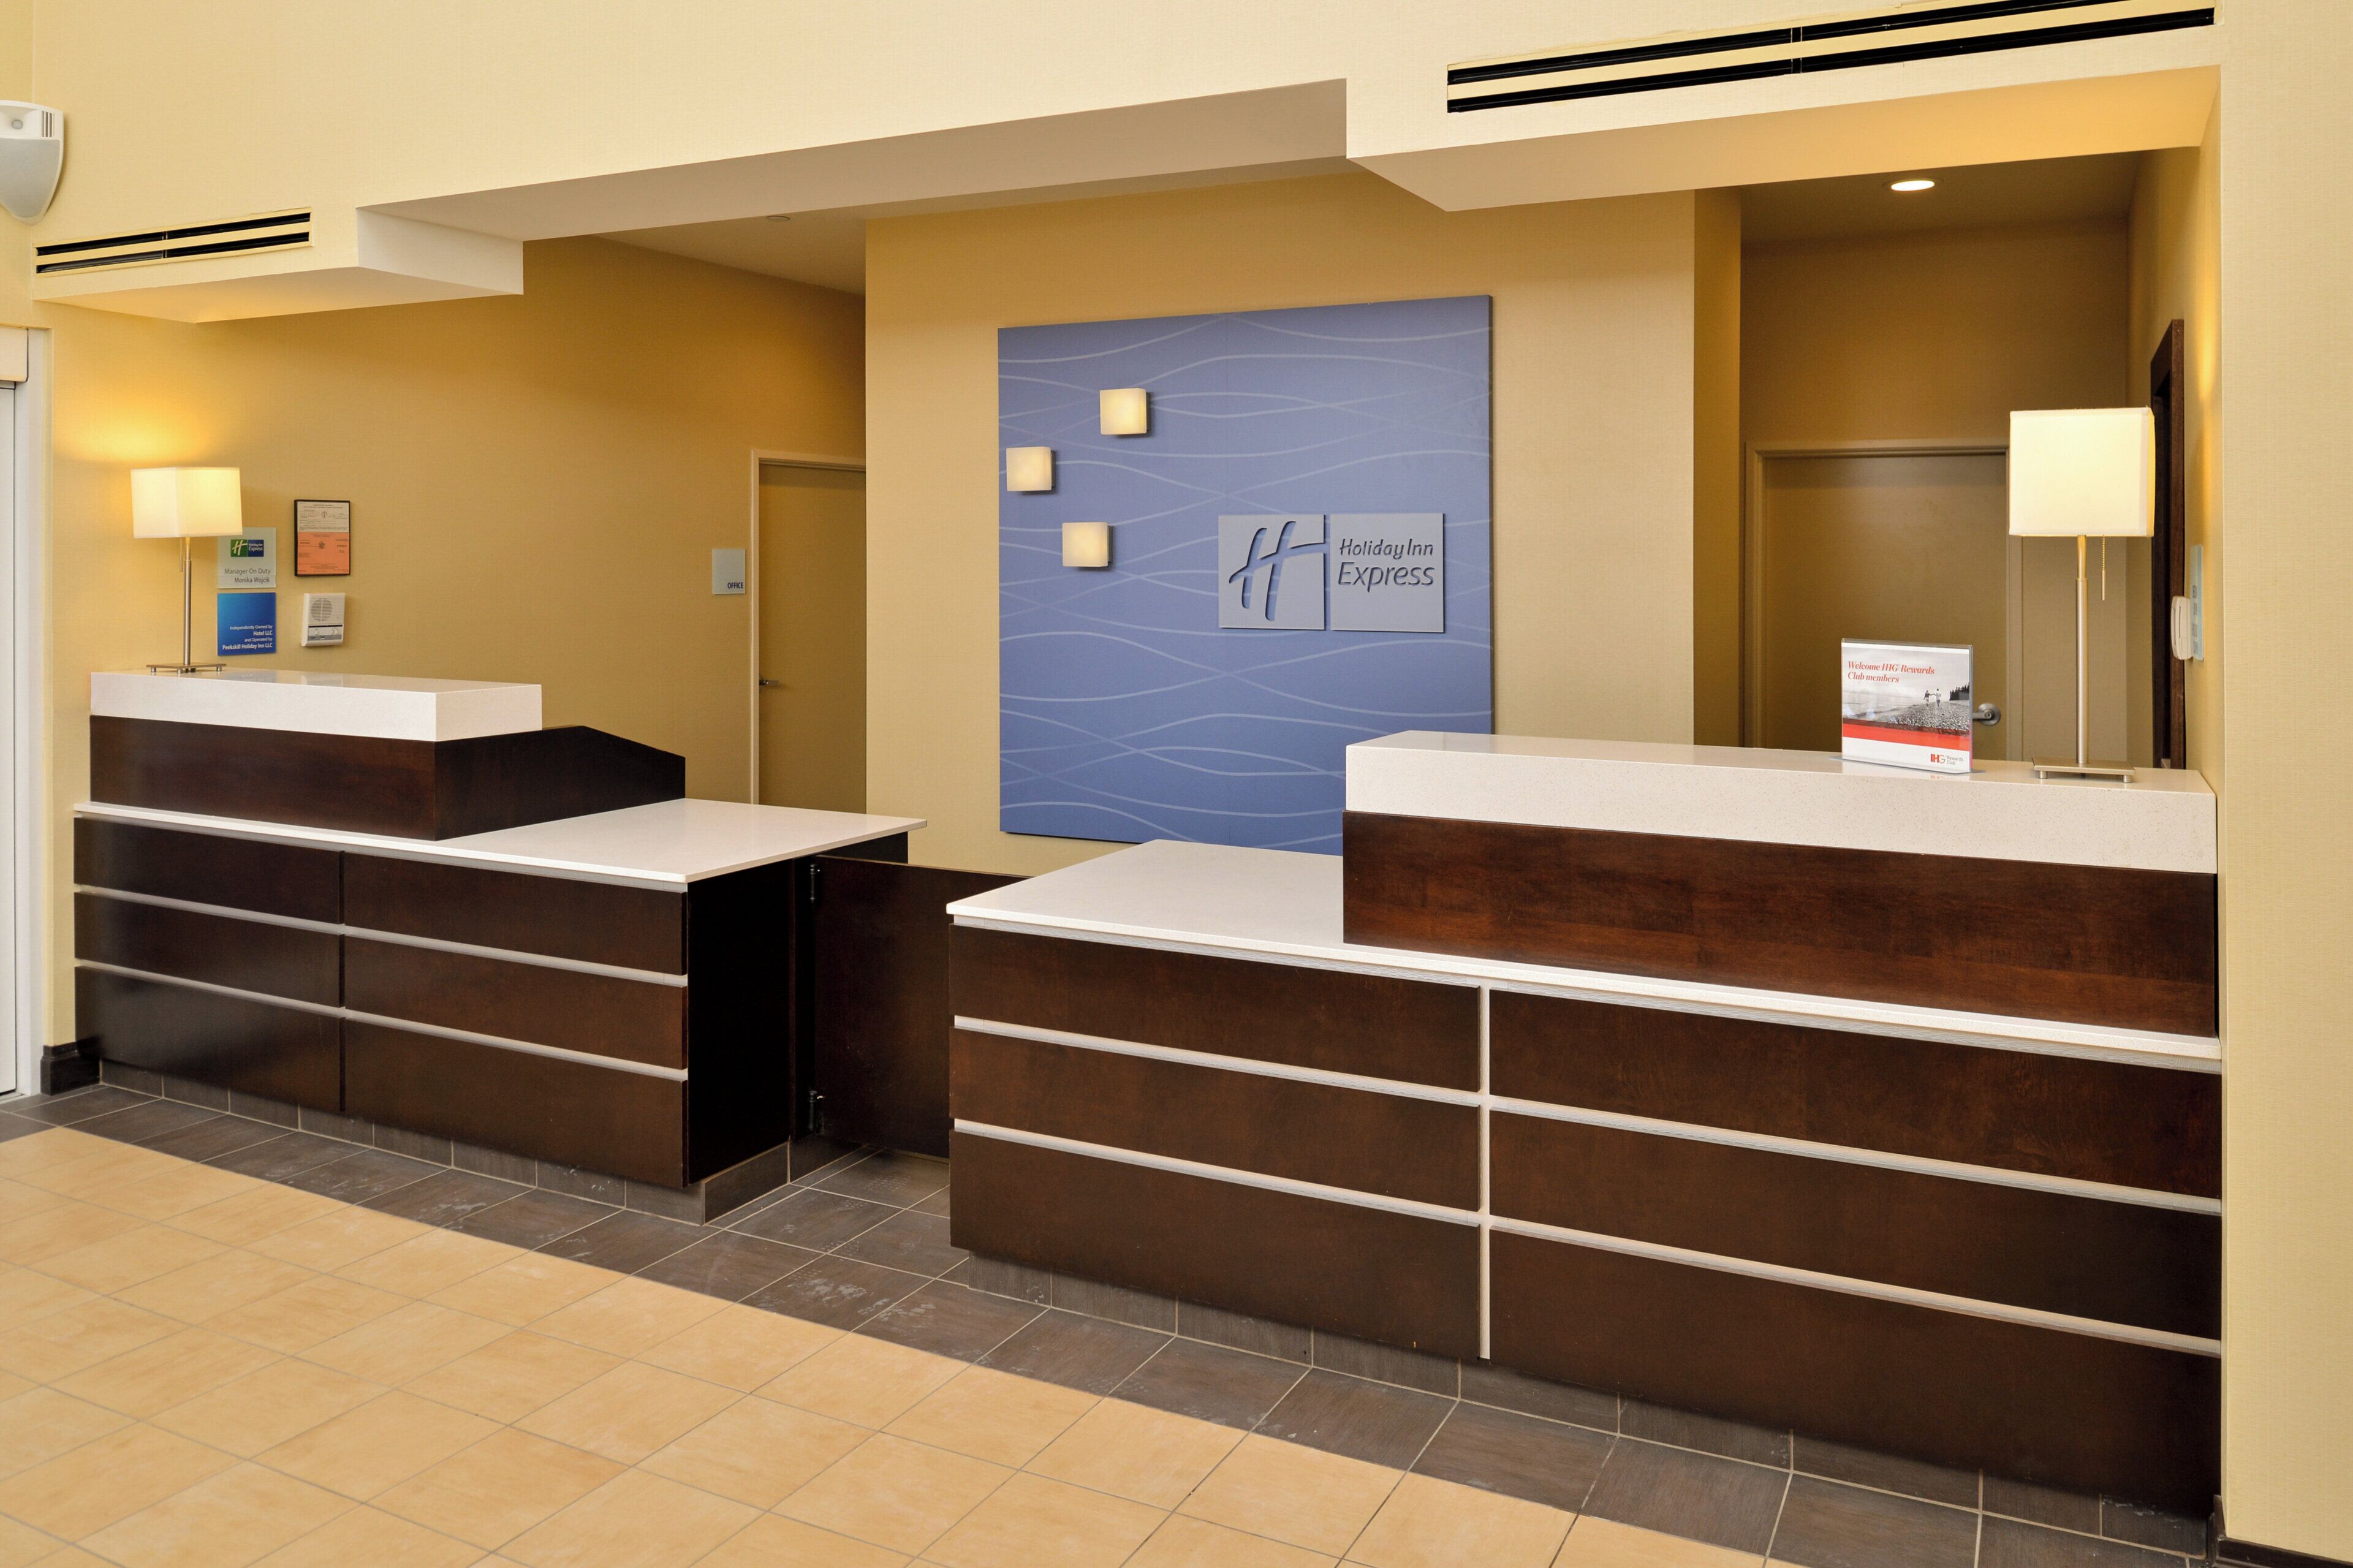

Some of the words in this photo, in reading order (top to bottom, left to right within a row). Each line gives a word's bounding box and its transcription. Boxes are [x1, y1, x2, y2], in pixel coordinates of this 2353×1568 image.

[1339, 539, 1404, 559] Holiday
[1408, 539, 1434, 556] Inn
[1338, 561, 1435, 593] Express
[1848, 661, 1881, 671] Welcome
[1881, 663, 1898, 672] IHG
[1900, 664, 1935, 675] Rewards
[1847, 672, 1865, 680] Club
[1866, 674, 1900, 683] members
[1931, 754, 1946, 763] IHG
